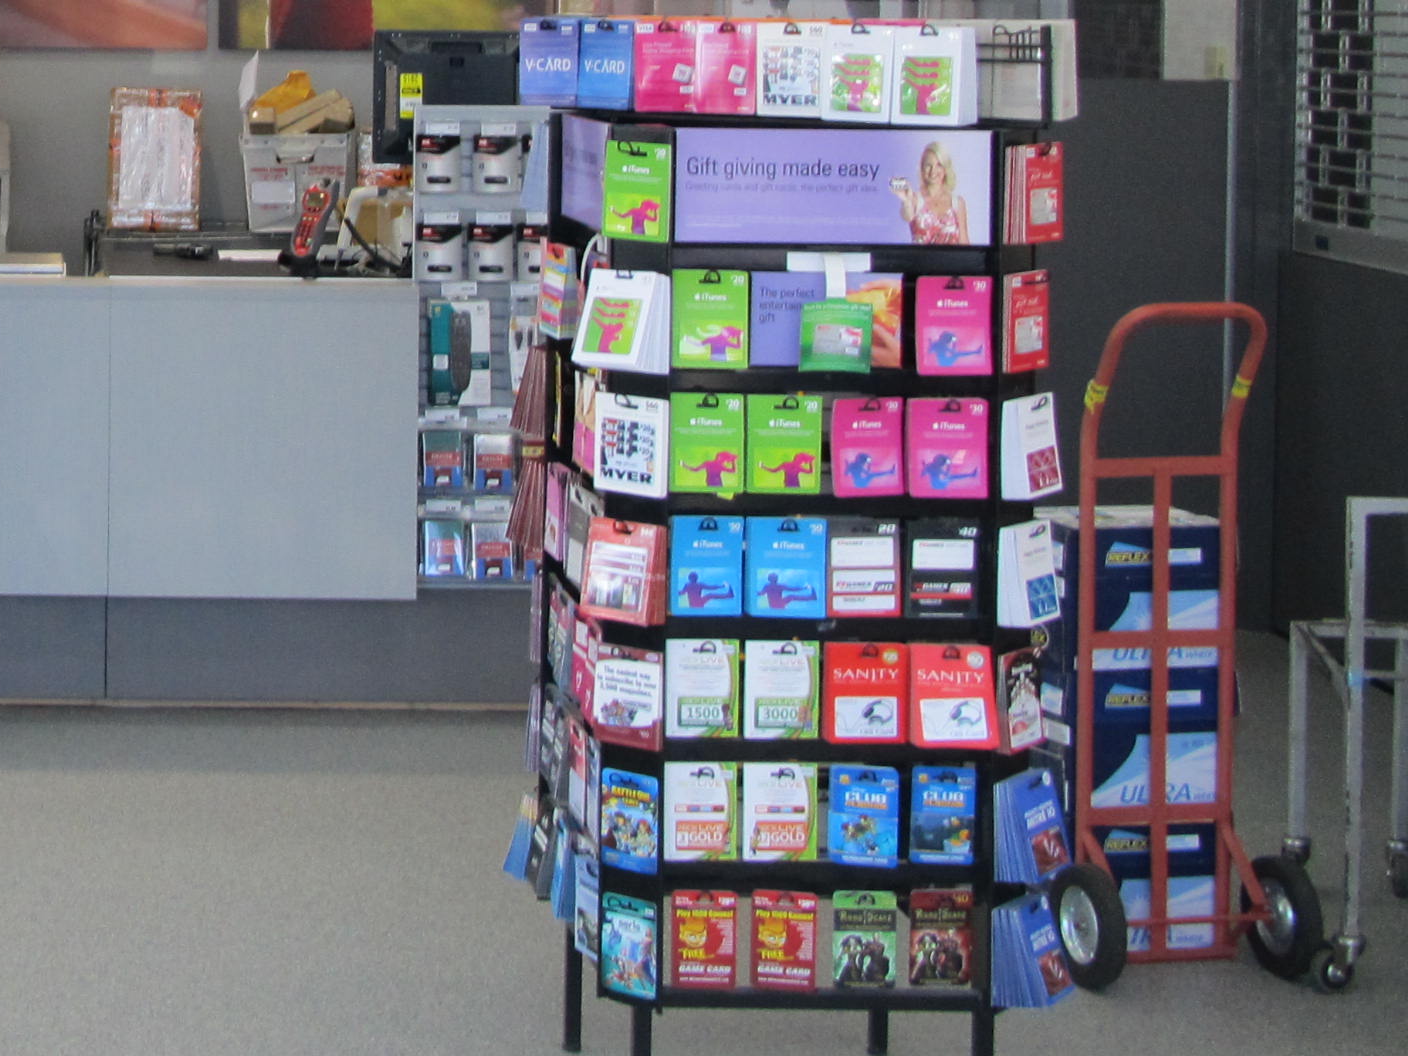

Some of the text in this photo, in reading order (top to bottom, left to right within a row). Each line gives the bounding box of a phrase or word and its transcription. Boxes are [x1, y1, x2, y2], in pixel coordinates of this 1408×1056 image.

[762, 94, 817, 105] MYER
[628, 165, 650, 174] iTunes
[686, 157, 880, 181] Gift giving made easy
[815, 183, 844, 193] perfect
[702, 293, 727, 301] iTunes
[760, 286, 815, 299] The perfect
[944, 299, 968, 307] iTunes
[759, 313, 775, 324] gift
[697, 418, 723, 427] iTunes
[775, 420, 801, 428] iTunes
[859, 420, 882, 429] iTunes
[940, 422, 965, 430] iTunes
[600, 466, 652, 484] MYER
[698, 541, 723, 549] iTunes
[779, 542, 805, 550] iTunes
[1108, 551, 1151, 563] REFLEX
[833, 668, 899, 683] SANITY
[917, 669, 985, 684] SANITY
[687, 707, 720, 719] 1500
[763, 708, 798, 720] 3000
[845, 791, 888, 804] CLUB
[923, 791, 965, 802] CLUB
[1120, 783, 1191, 804] ULA
[698, 823, 724, 833] LIVE
[777, 824, 804, 833] LIVE
[689, 831, 723, 842] GOLD
[770, 832, 805, 842] GOLD
[676, 909, 691, 918] Play
[755, 909, 770, 919] Play
[678, 965, 732, 974] GAME CARD
[757, 965, 811, 976] GAME CARD
